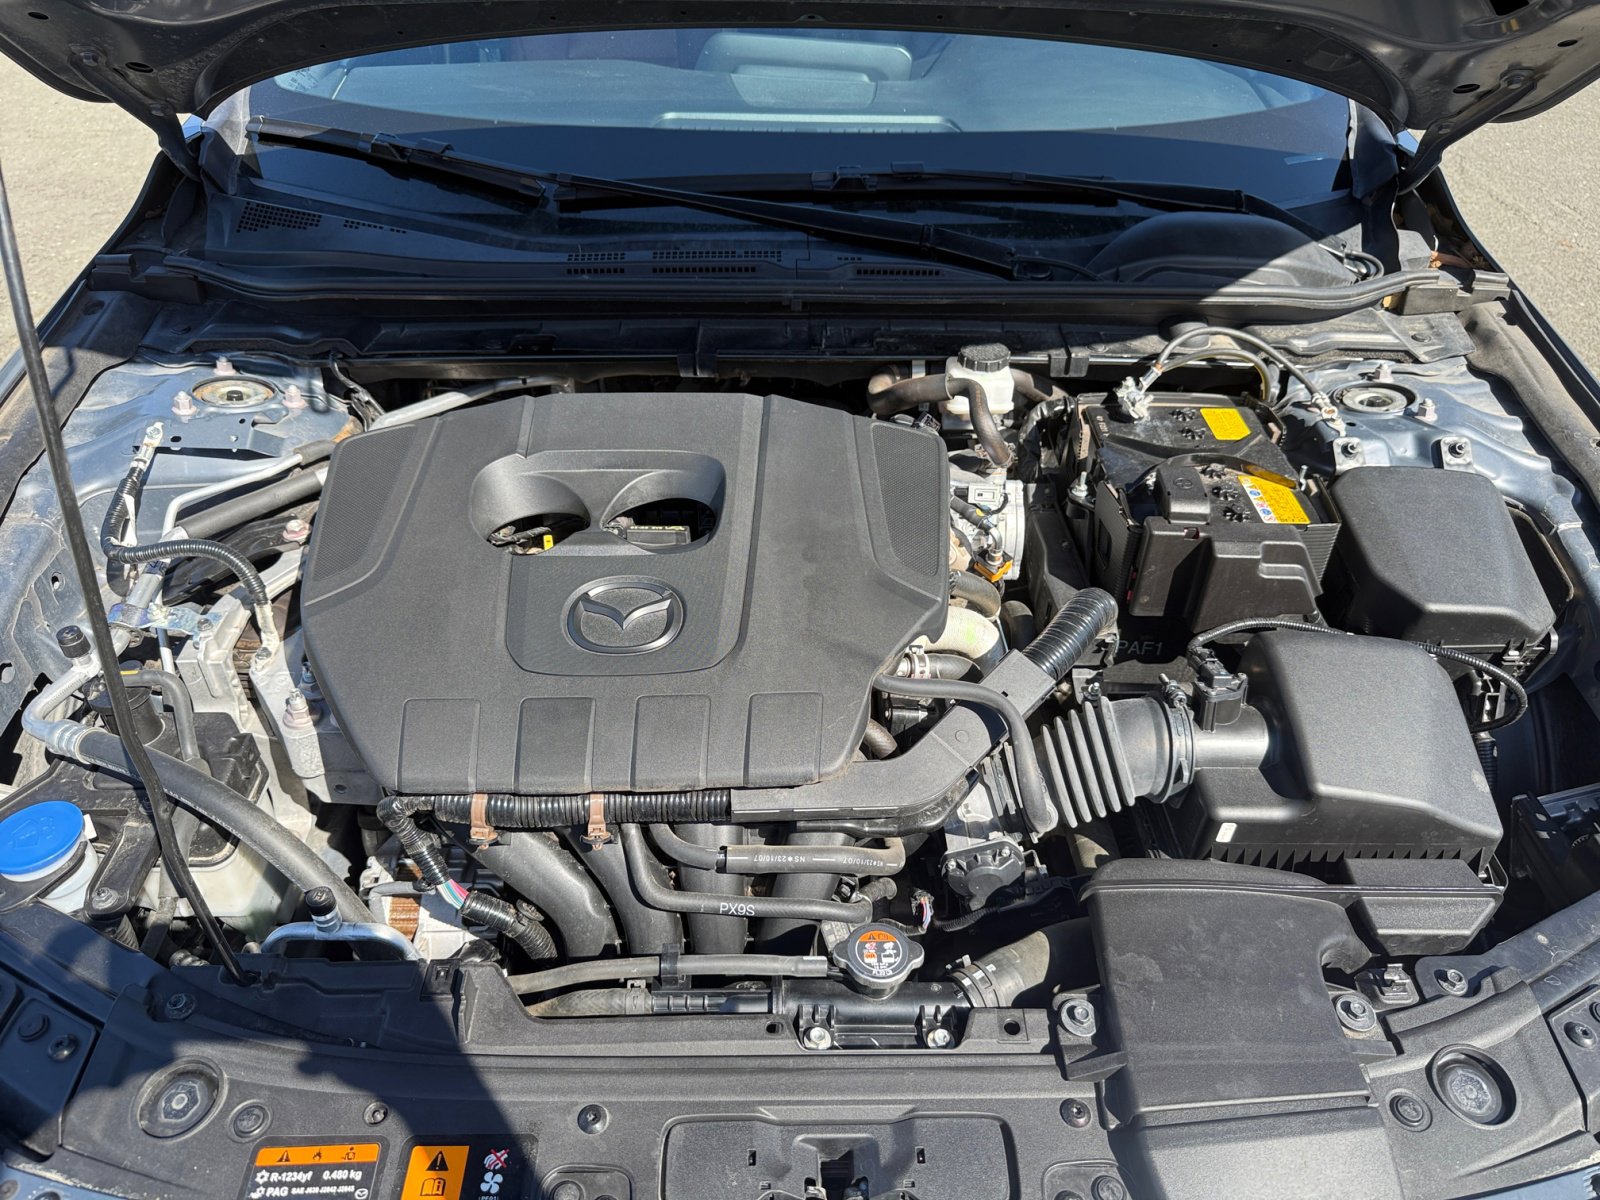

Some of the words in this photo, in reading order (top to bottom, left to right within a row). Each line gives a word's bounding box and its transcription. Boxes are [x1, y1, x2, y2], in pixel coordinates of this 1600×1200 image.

[719, 901, 756, 917] PX9S
[269, 1170, 313, 1184] R-1234yf
[322, 1169, 348, 1180] 0.480
[349, 1169, 363, 1181] kg
[265, 1186, 289, 1197] PAG
